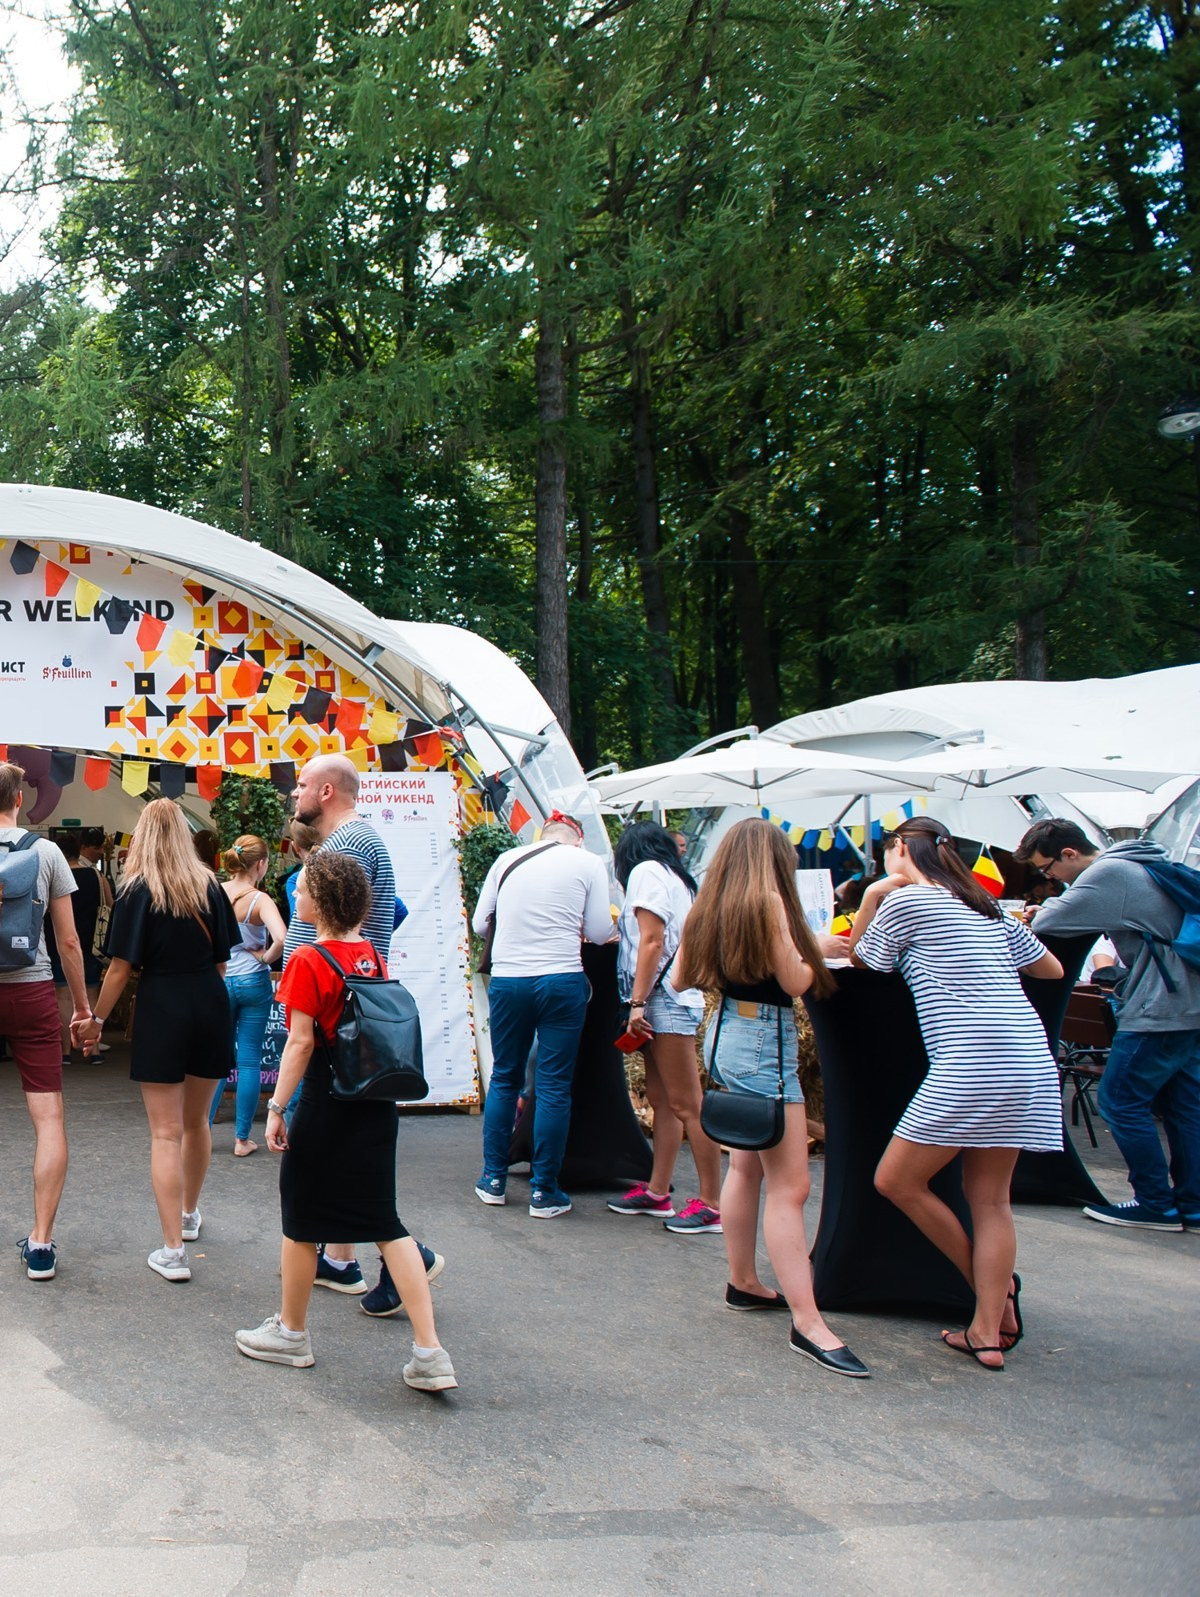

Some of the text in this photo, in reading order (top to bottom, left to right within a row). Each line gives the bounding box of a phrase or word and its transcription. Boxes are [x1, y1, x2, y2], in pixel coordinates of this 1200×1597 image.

[22, 599, 175, 622] WEKND
[361, 777, 426, 789] ЬГИЙСКИЙ
[356, 792, 435, 805] НОЙ УИКЕНД
